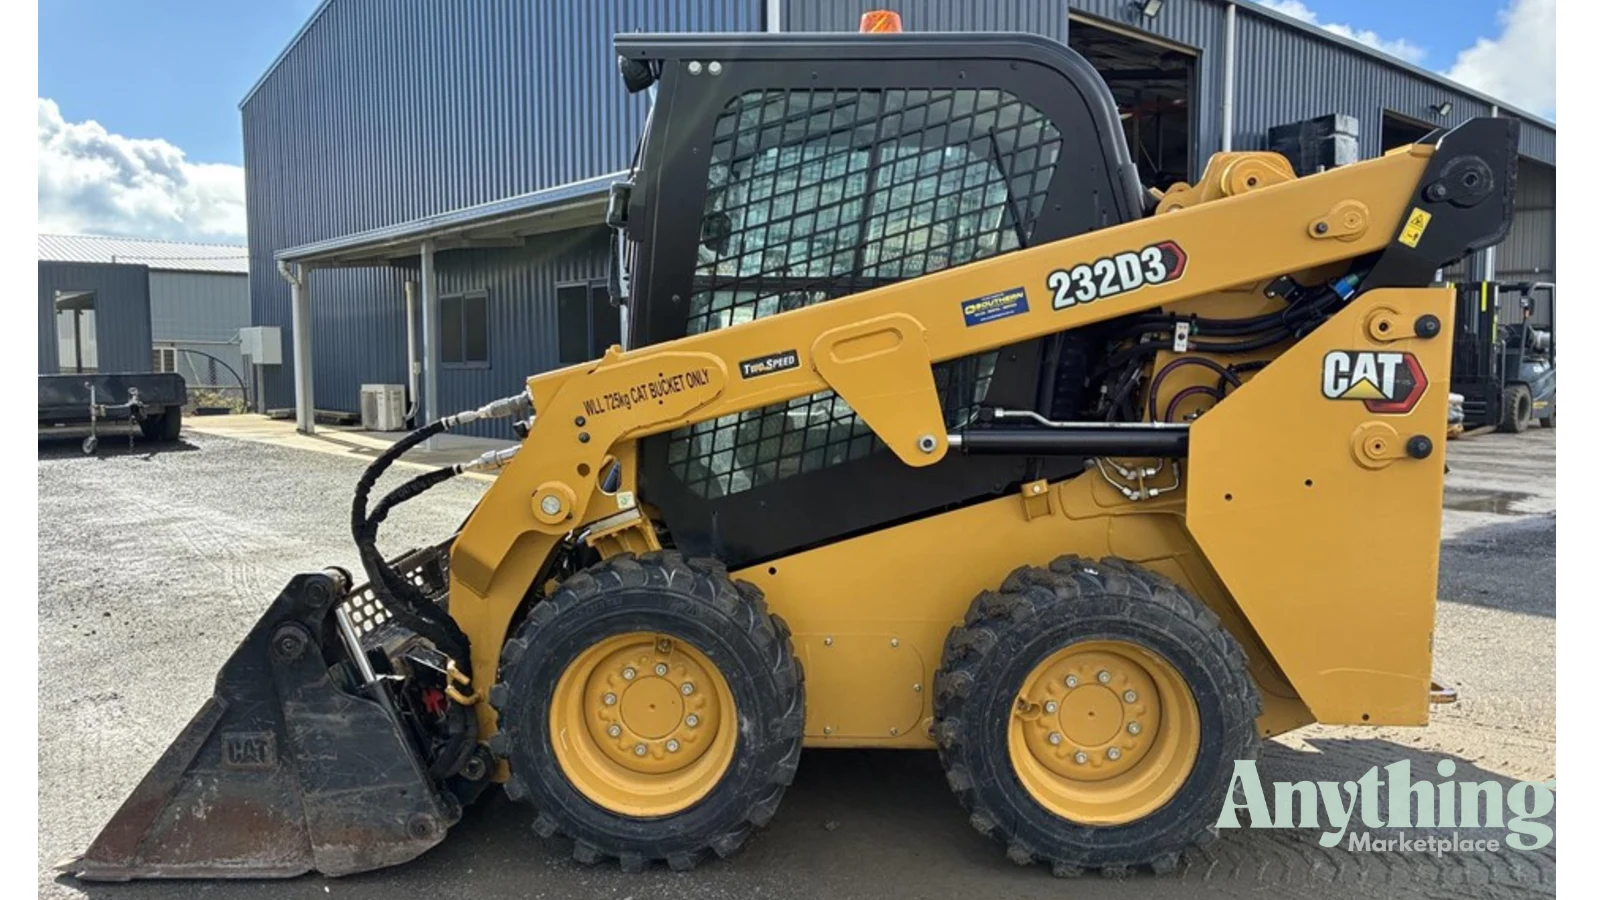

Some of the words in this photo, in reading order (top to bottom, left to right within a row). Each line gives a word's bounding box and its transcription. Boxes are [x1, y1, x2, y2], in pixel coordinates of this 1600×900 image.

[1049, 246, 1167, 309] 232D3
[583, 397, 605, 416] WLL
[604, 391, 632, 410] 725kg
[630, 384, 650, 404] CAT
[648, 374, 686, 399] BUCKET
[685, 368, 710, 389] ONLY
[1323, 351, 1403, 400] CAT
[228, 737, 268, 764] CAT
